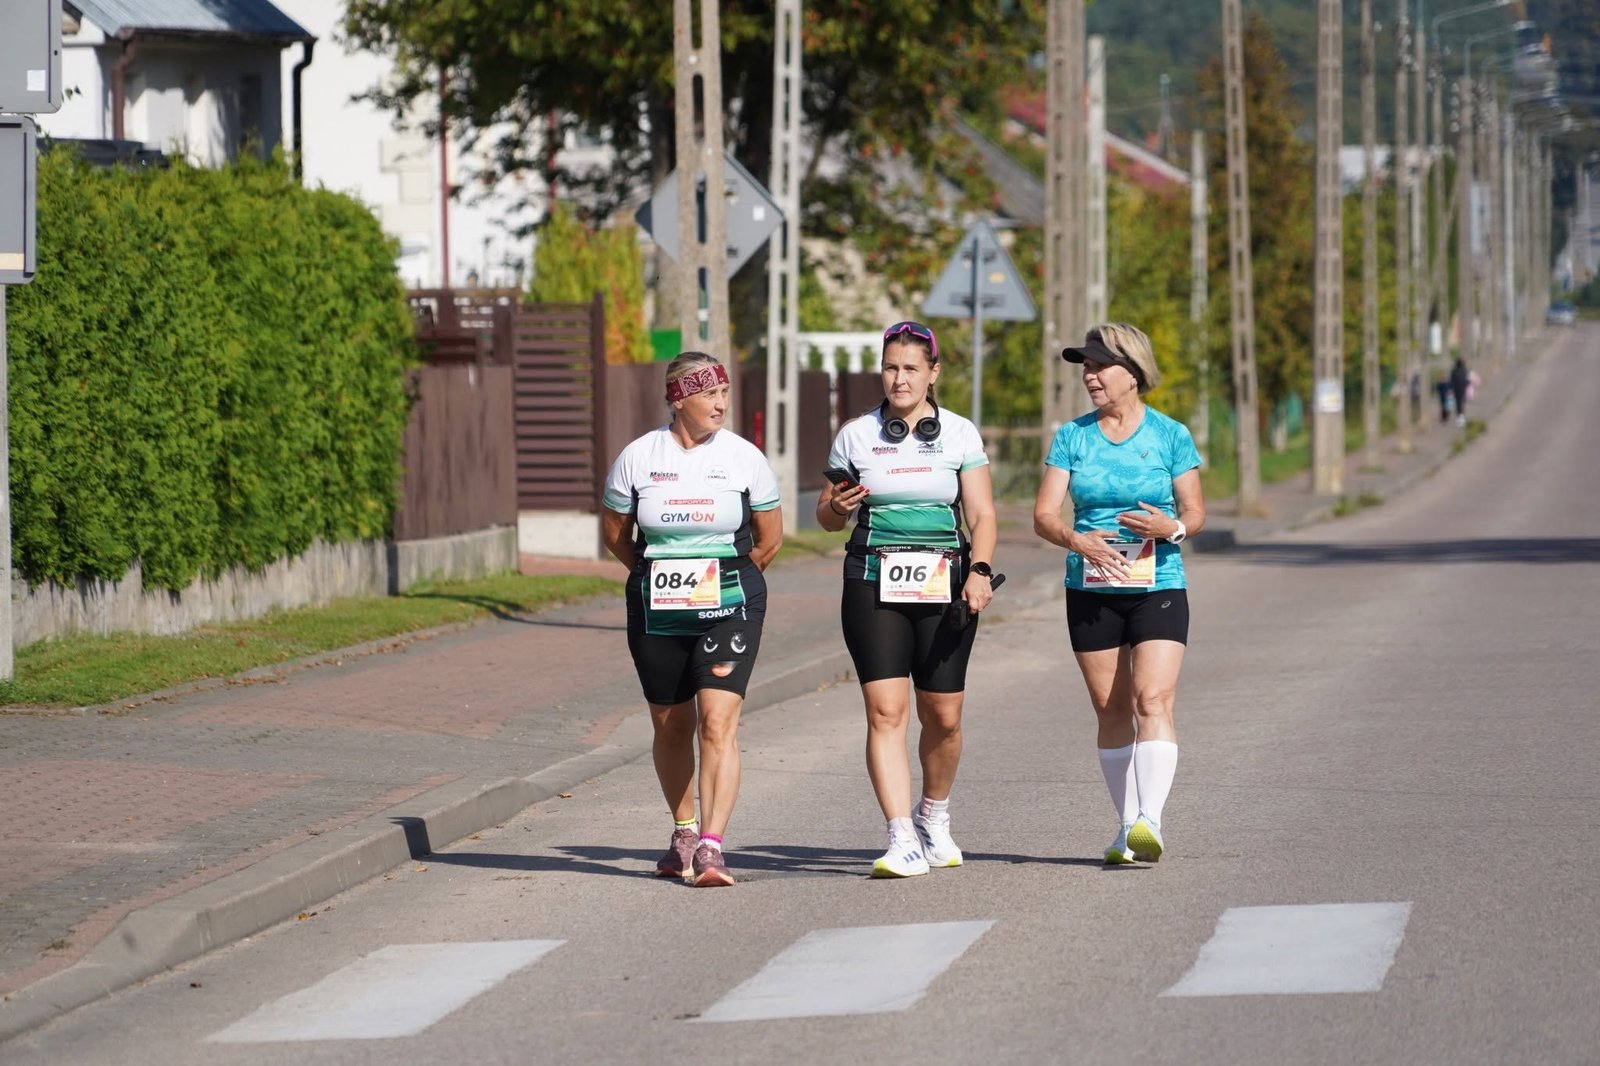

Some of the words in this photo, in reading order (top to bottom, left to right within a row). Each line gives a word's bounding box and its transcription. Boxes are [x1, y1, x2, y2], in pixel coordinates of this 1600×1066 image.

[661, 511, 715, 523] GYMON
[654, 572, 698, 589] 084
[889, 565, 928, 582] 016
[698, 607, 737, 619] SONAX
